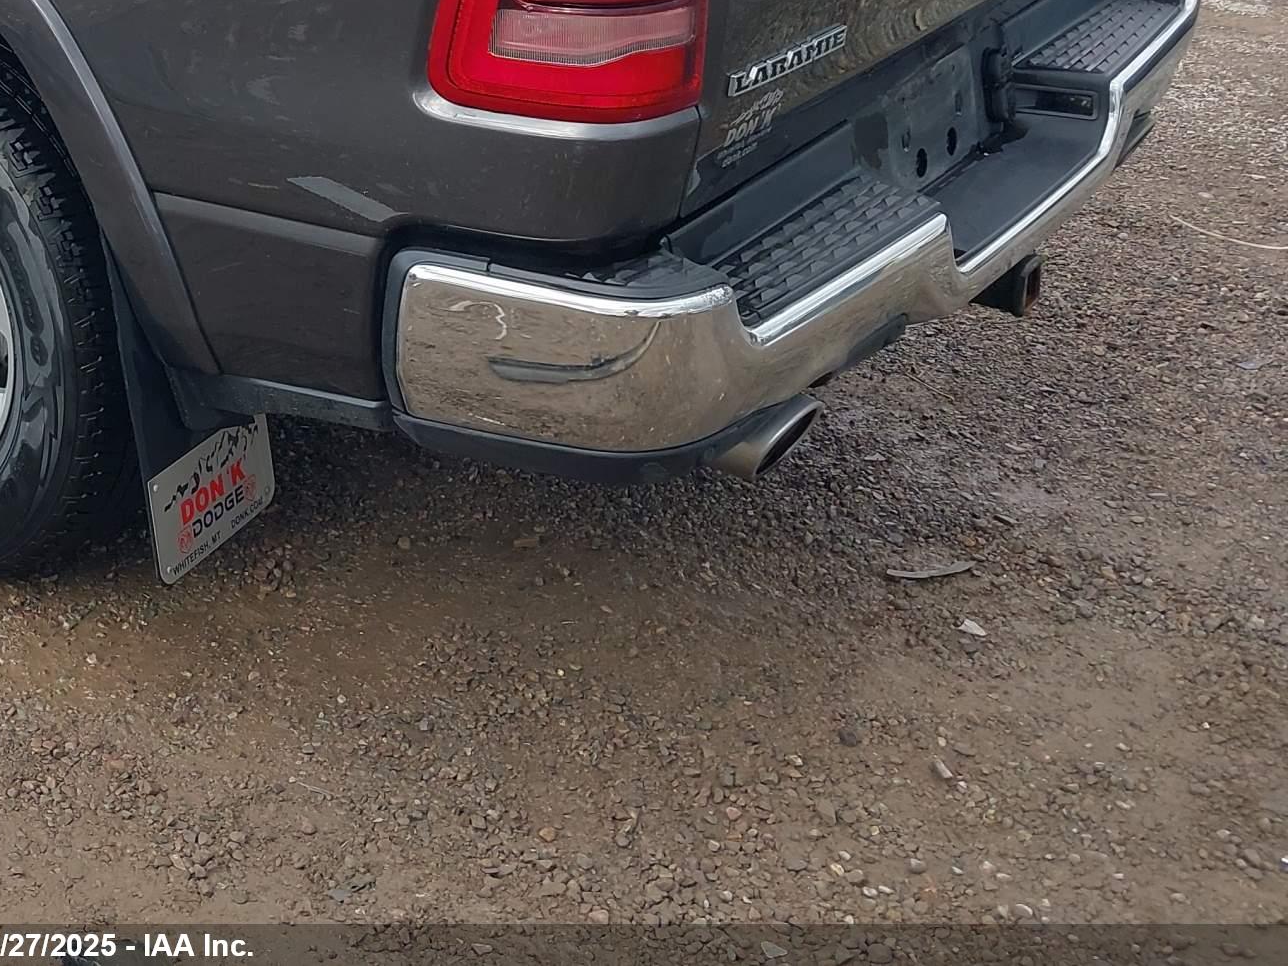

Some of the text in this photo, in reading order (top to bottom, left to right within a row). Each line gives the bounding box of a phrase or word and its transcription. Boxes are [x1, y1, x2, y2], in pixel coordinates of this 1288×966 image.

[727, 24, 847, 97] LARAMIE
[723, 115, 760, 147] DON
[179, 473, 225, 526] DON
[191, 485, 245, 538] DODGE
[212, 530, 222, 542] MT
